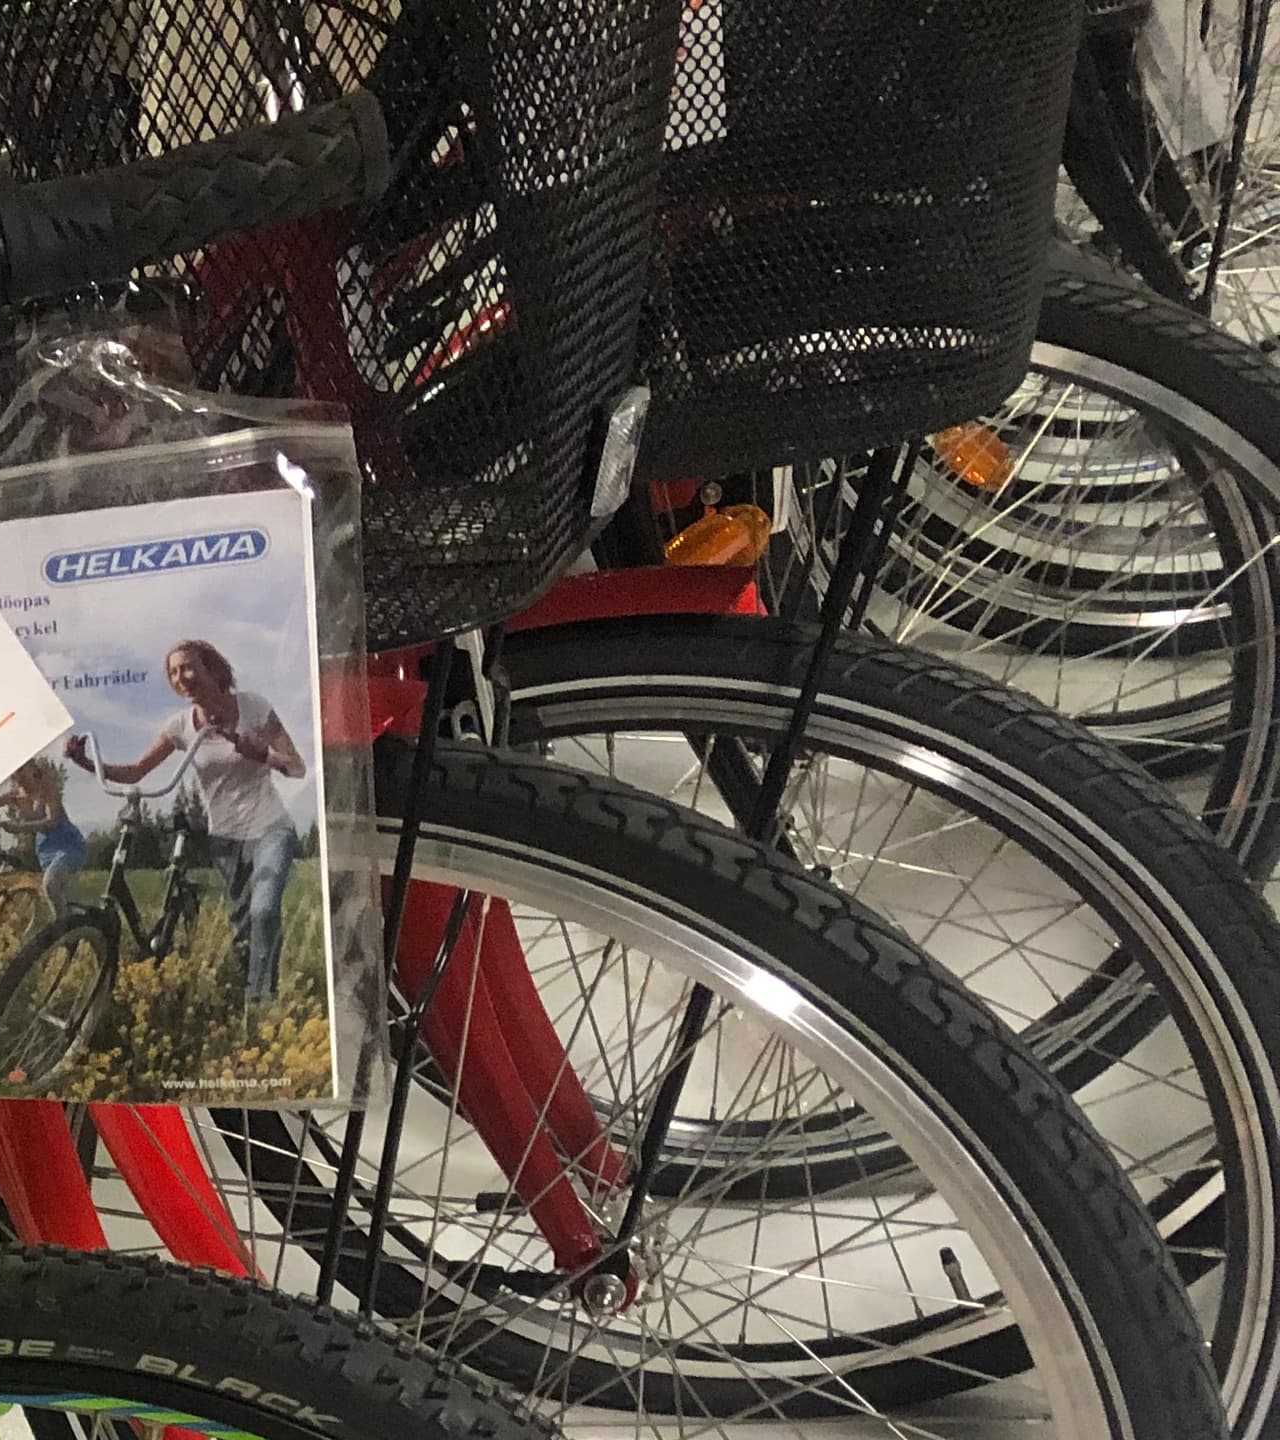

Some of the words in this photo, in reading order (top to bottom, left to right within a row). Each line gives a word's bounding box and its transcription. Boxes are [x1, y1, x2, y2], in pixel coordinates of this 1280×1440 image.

[55, 532, 258, 581] HELKAMA
[15, 620, 57, 640] cykel
[63, 668, 148, 690] Fahrräder
[135, 1353, 341, 1427] BLACK
